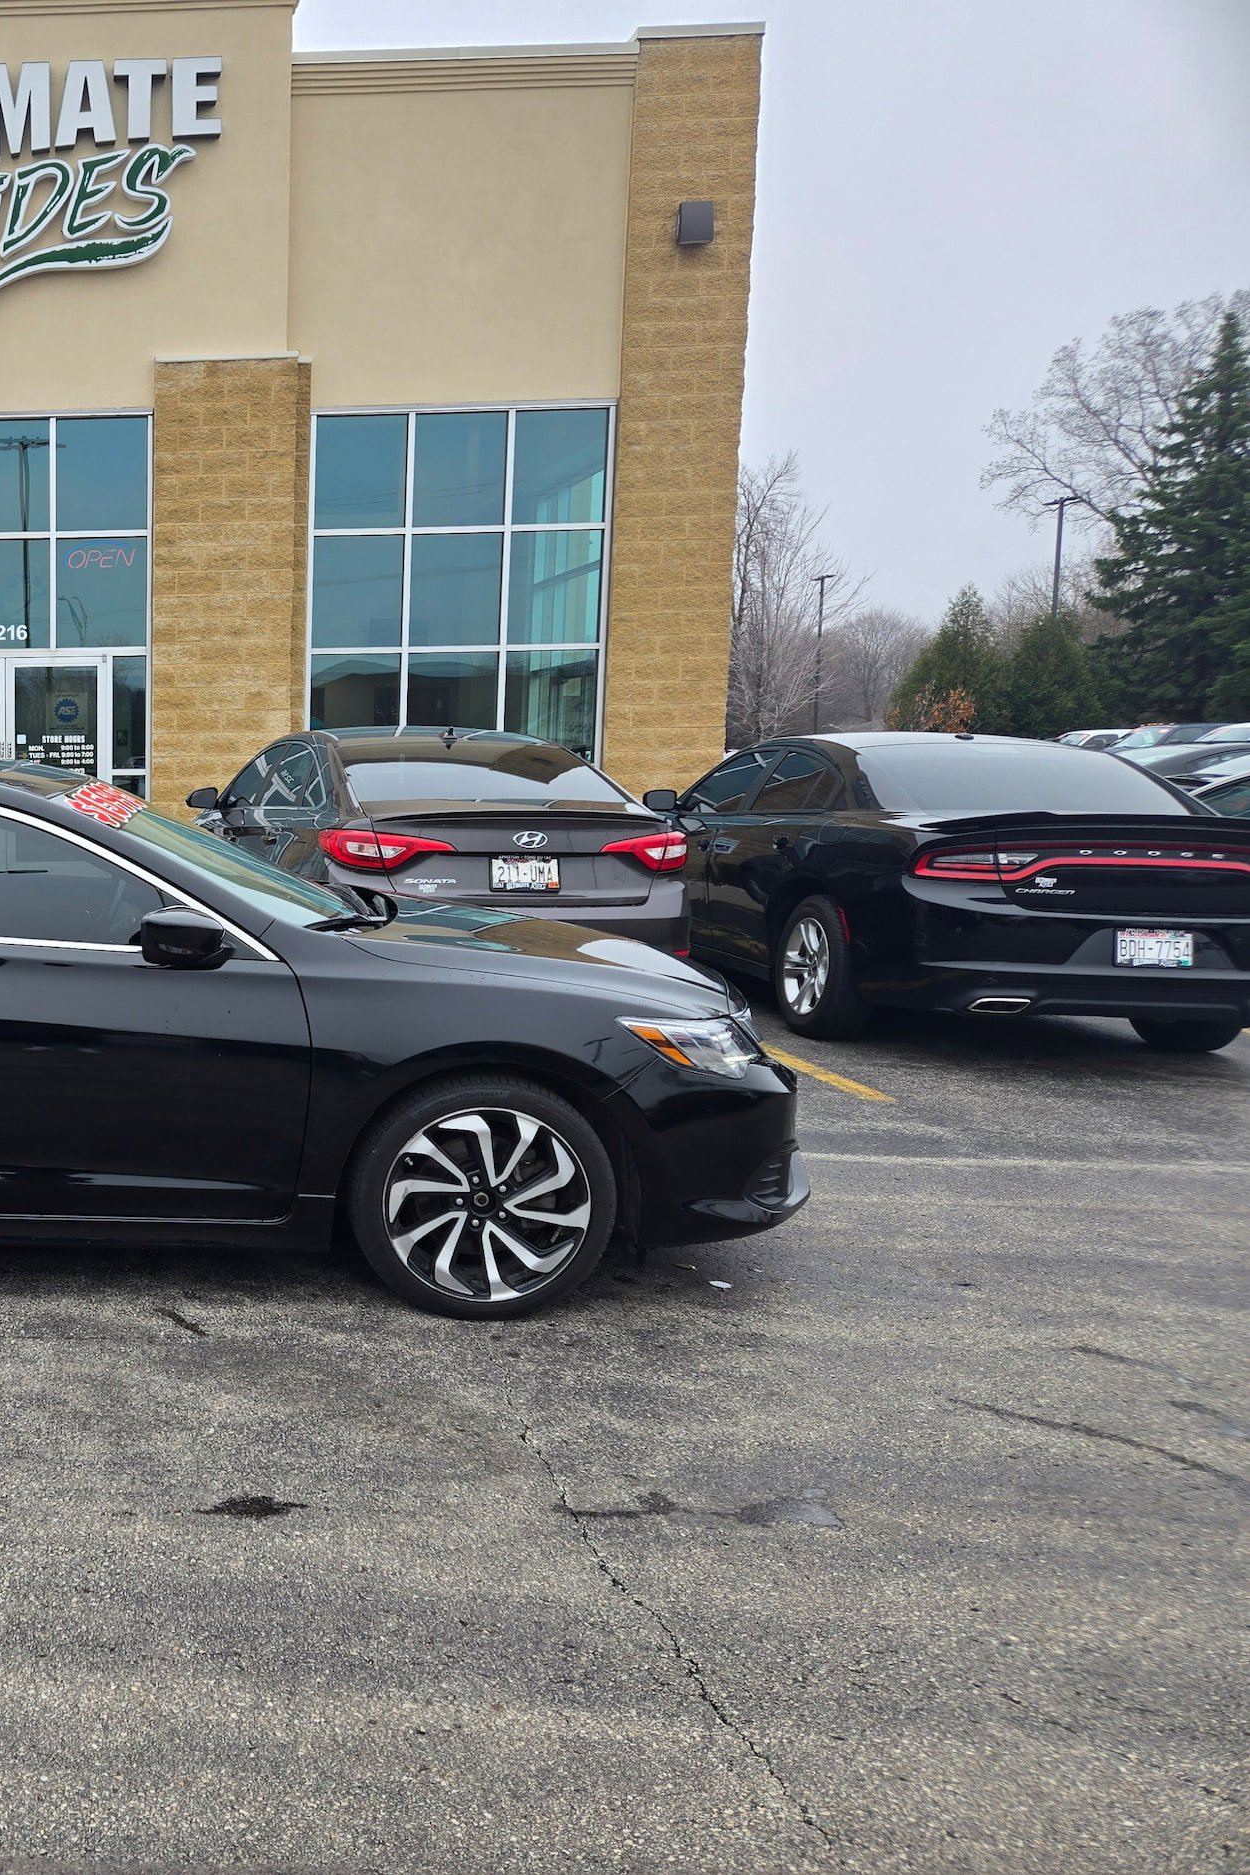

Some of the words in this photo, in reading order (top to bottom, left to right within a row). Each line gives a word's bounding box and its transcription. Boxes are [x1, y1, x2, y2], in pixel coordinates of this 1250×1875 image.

[67, 548, 136, 569] OPEN
[42, 735, 63, 744] STORE
[64, 735, 86, 744] HOURS
[1079, 849, 1225, 860] DODGE
[1015, 888, 1076, 896] CHARGER
[1120, 939, 1190, 958] BDH-7754
